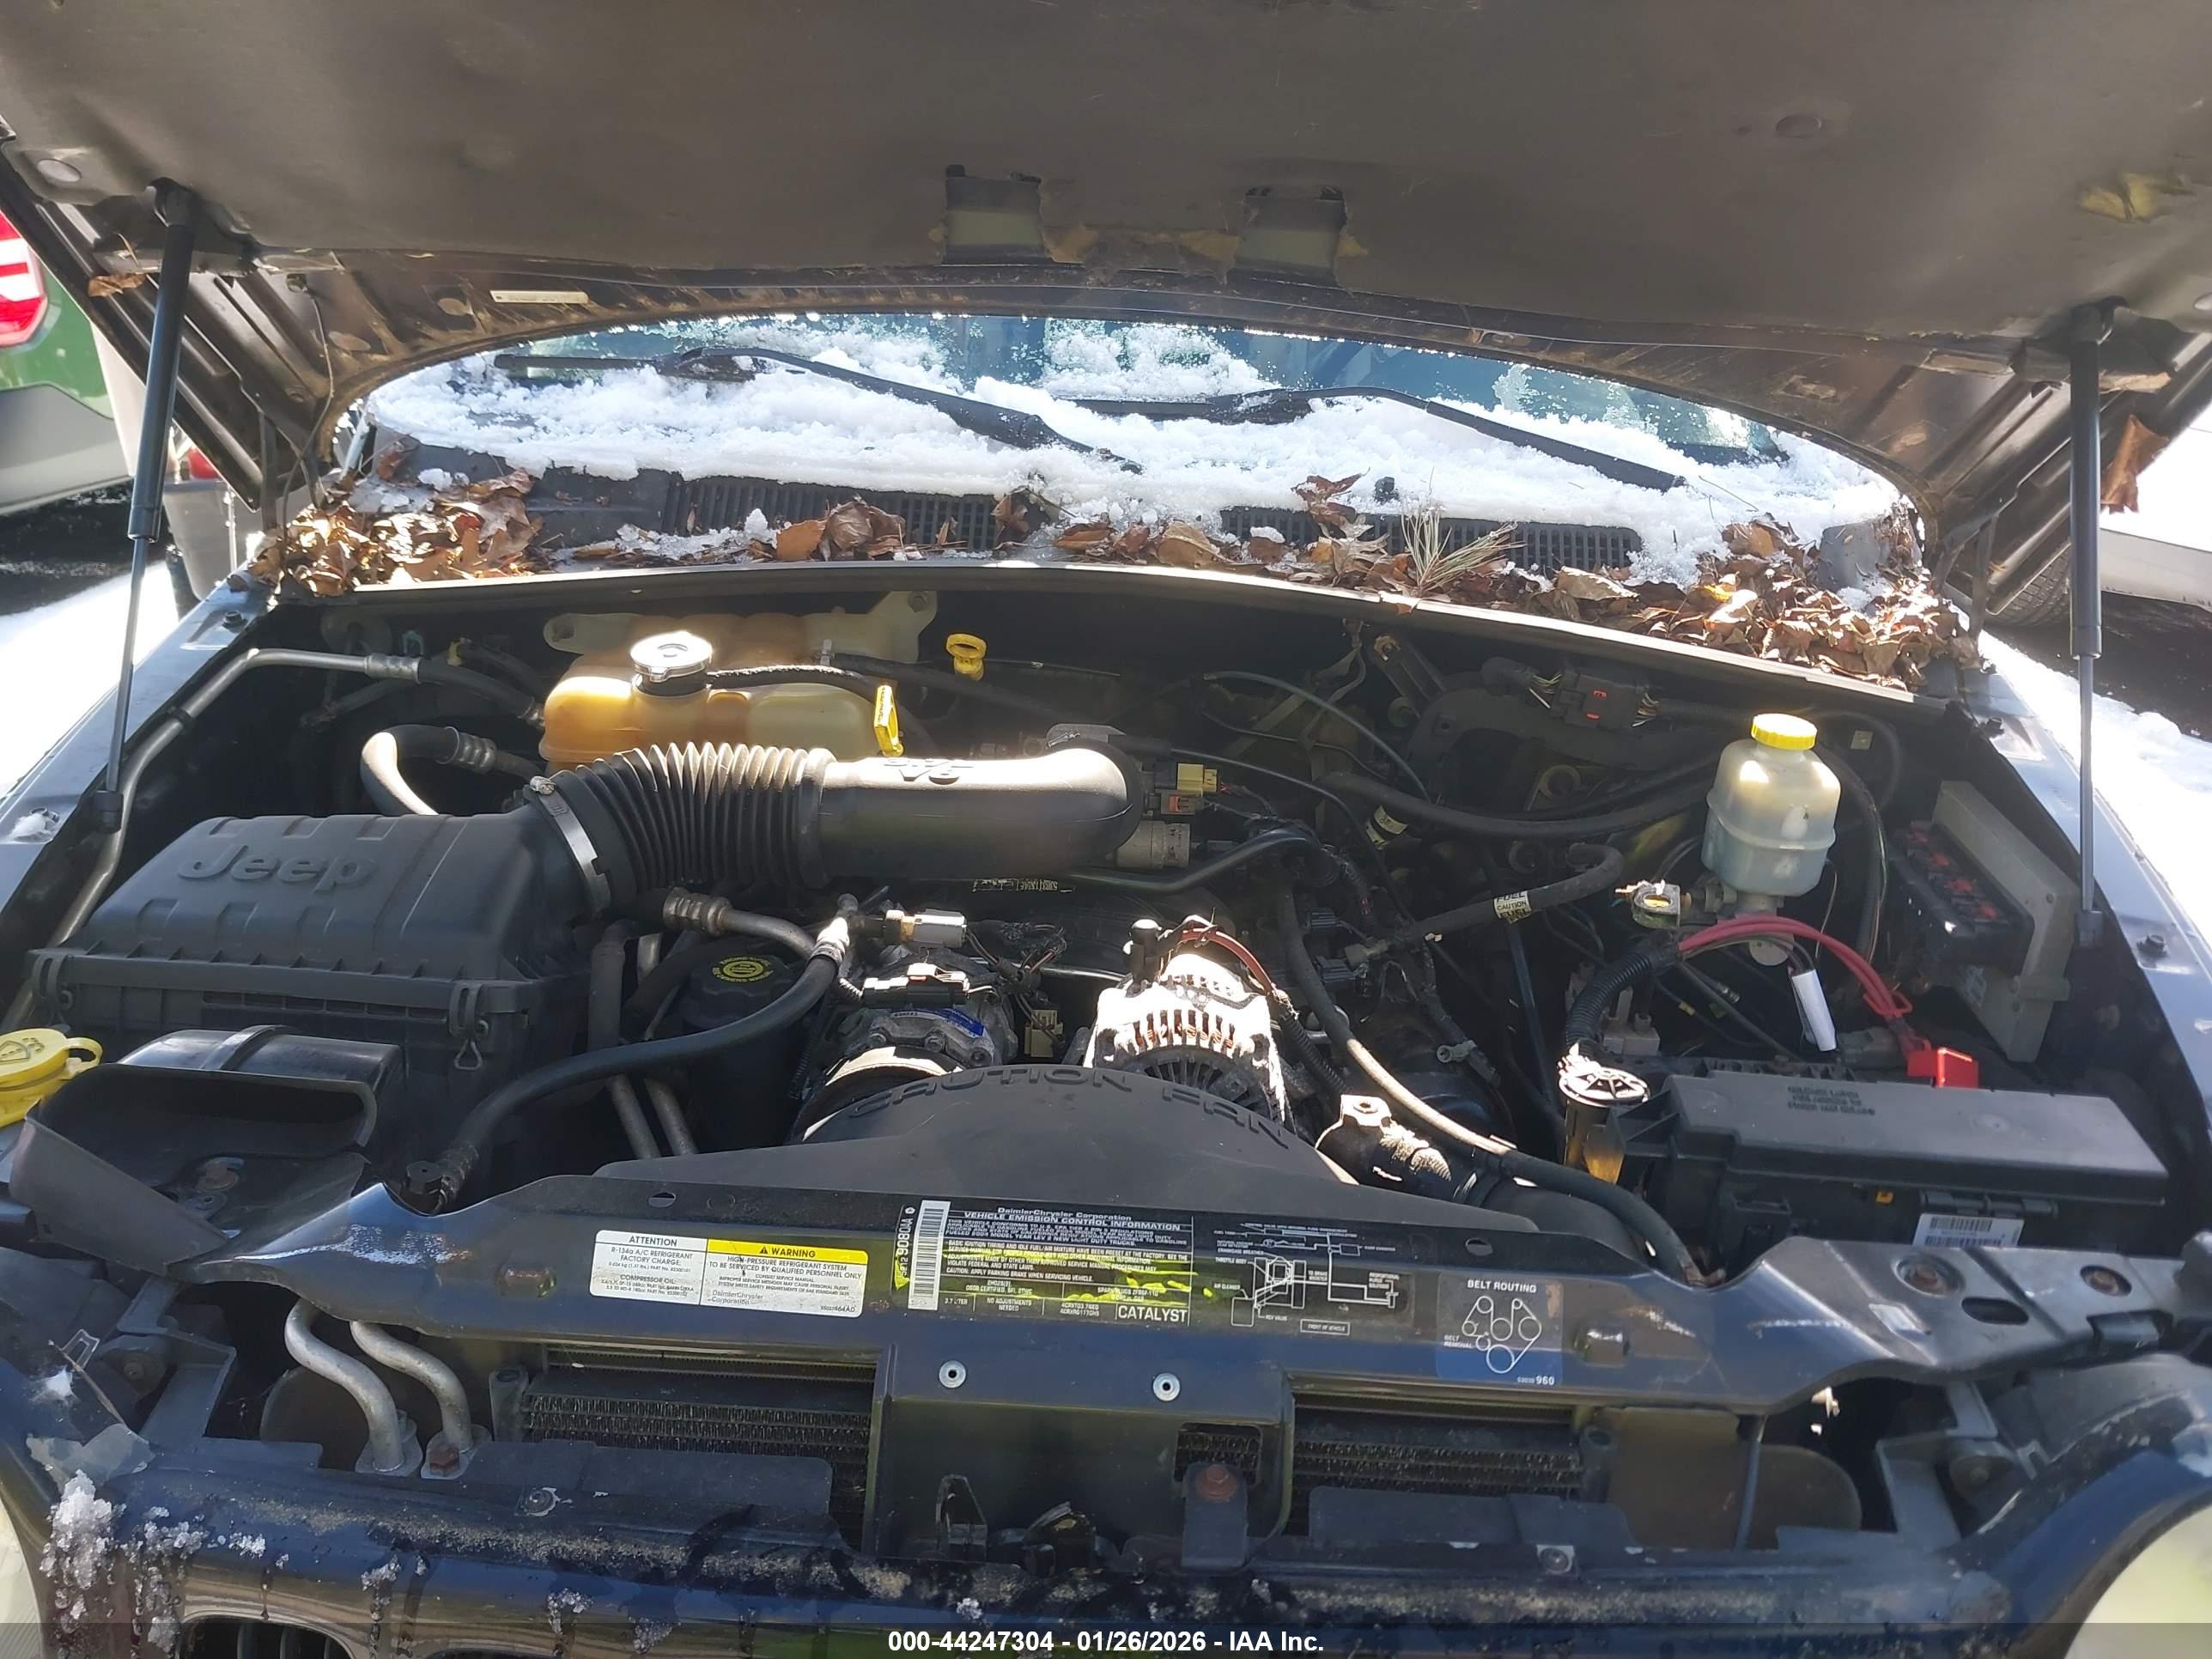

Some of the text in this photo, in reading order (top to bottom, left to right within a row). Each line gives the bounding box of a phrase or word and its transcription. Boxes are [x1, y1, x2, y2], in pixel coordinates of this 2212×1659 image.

[178, 843, 379, 894] Jeep
[1498, 901, 1527, 910] CAUTION
[850, 1067, 1289, 1150] CAUTION FAN
[998, 1207, 1131, 1221] DaimlerChrysler Corporation
[964, 1212, 1181, 1231] VEHICLE EMISSION CONTROL INFORMATION
[629, 1236, 677, 1247] ATTENTION
[651, 1250, 693, 1259] REFRIGERANT
[771, 1247, 816, 1258] WARNING
[727, 1255, 777, 1267] HIGH-PRESSURE
[779, 1261, 822, 1270] REFRIGERANT
[771, 1266, 805, 1275] QUALIFIED
[805, 1269, 842, 1278] PERSONNEL
[620, 1274, 664, 1283] COMPRESSOR
[1468, 1279, 1537, 1293] BELT ROUTING
[713, 1290, 763, 1299] DaimlerChrysler
[711, 1297, 750, 1305] Corporation
[1118, 1305, 1188, 1322] CATALYST
